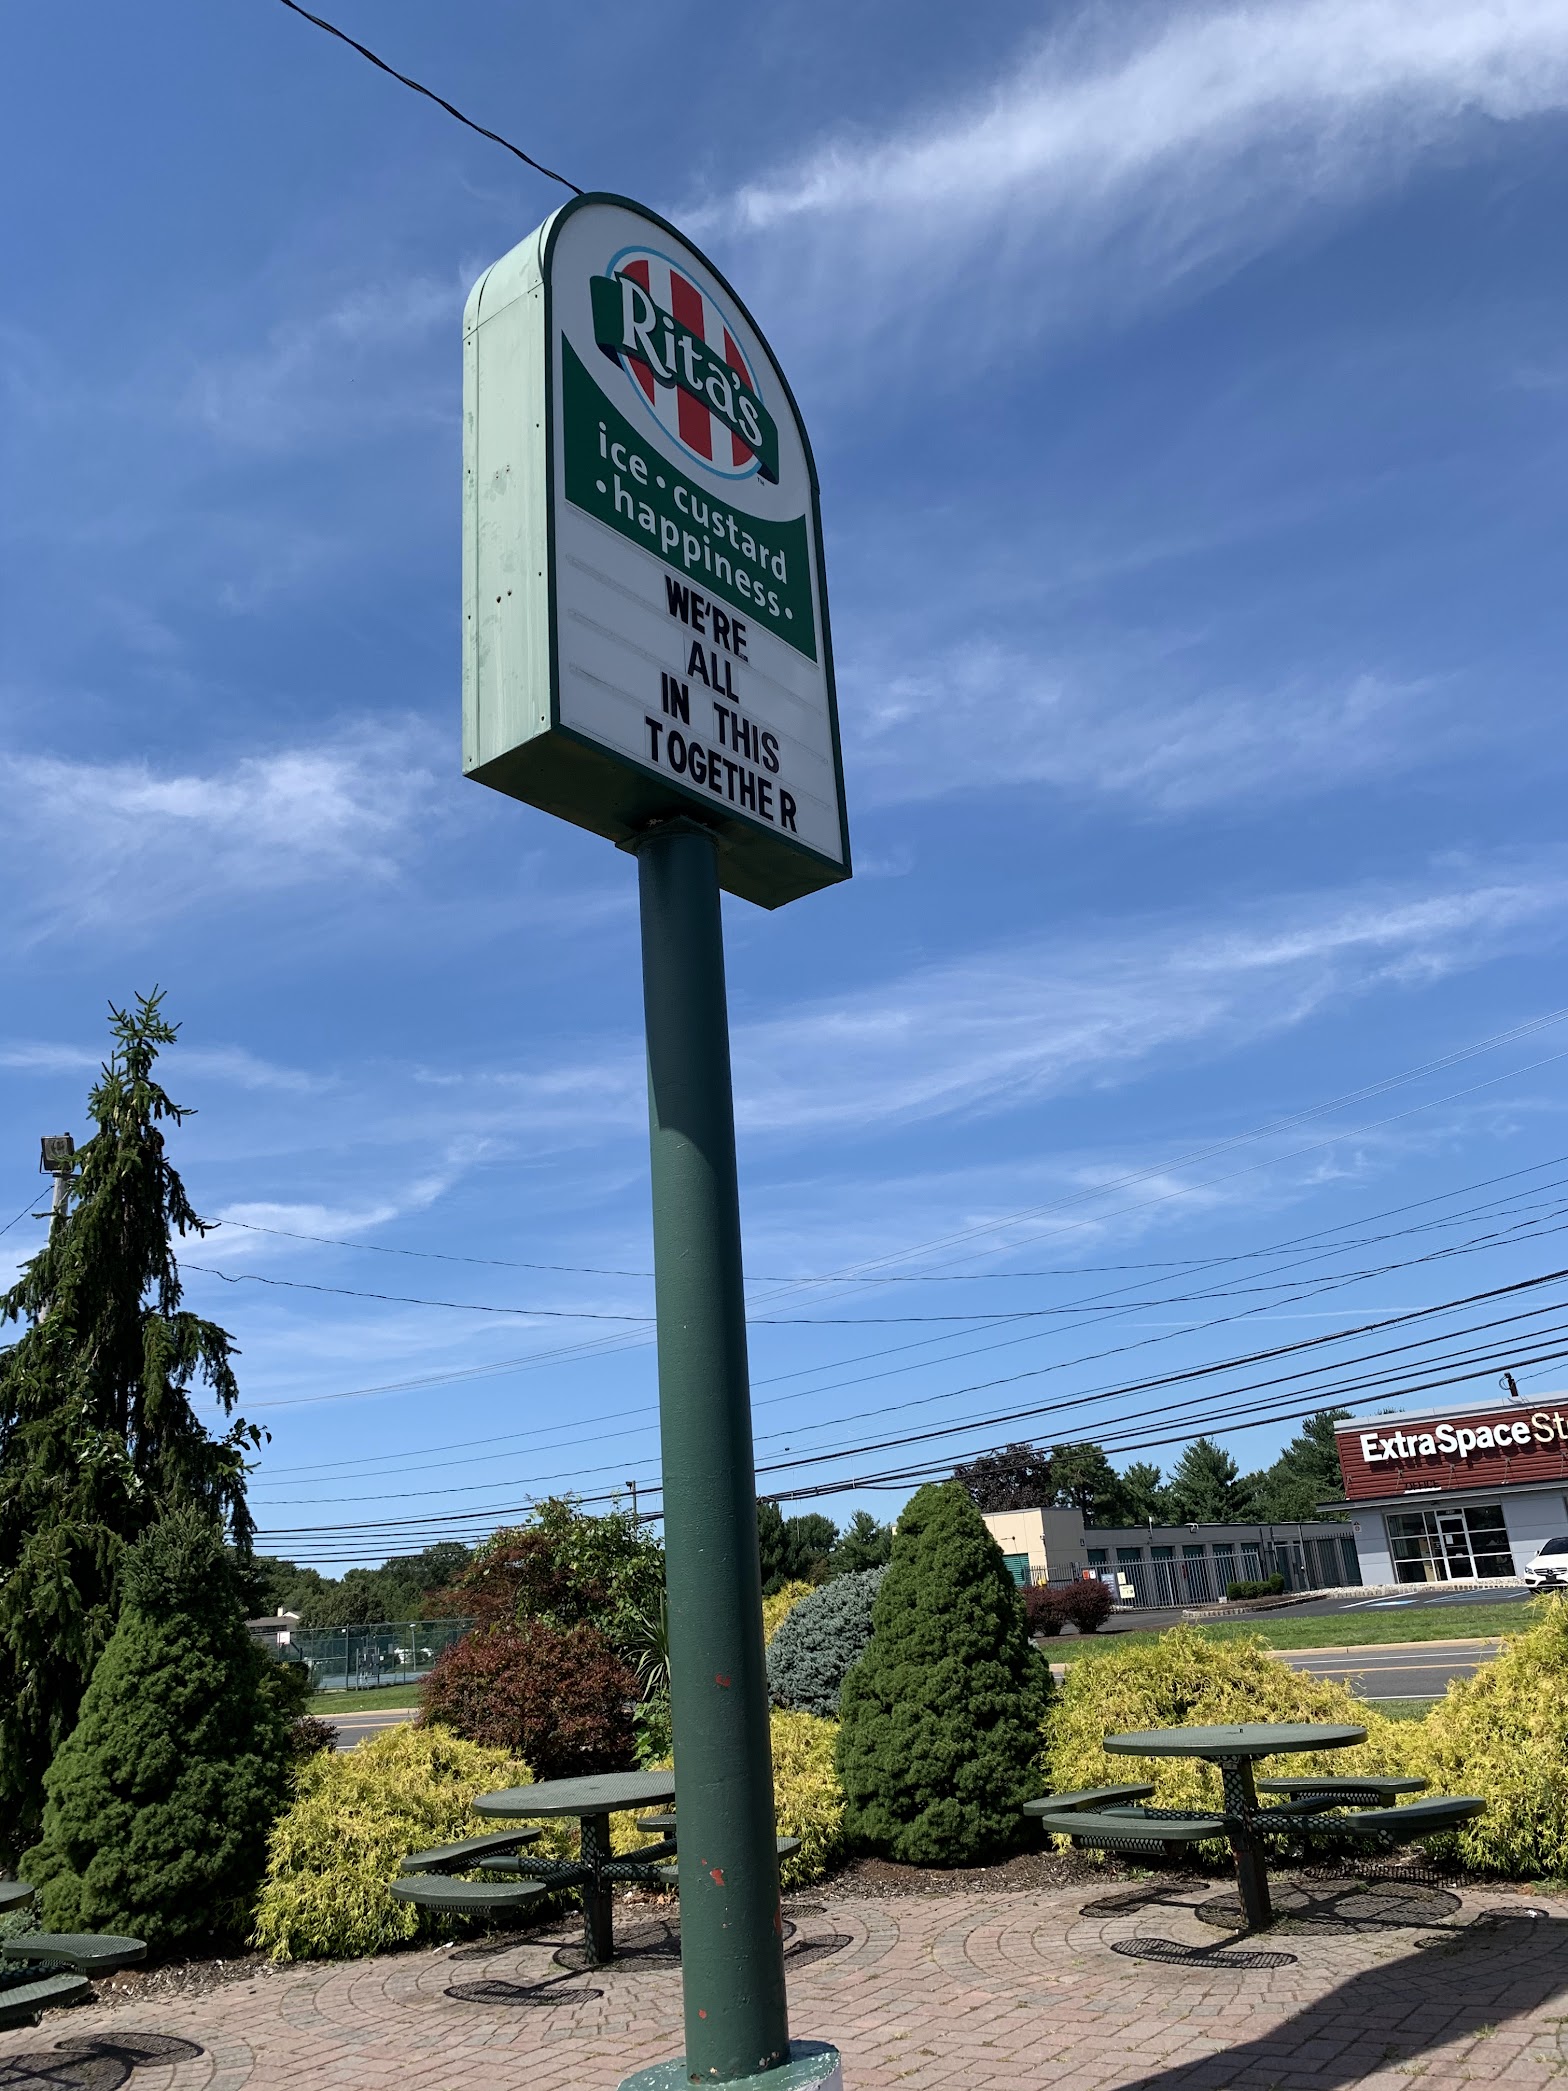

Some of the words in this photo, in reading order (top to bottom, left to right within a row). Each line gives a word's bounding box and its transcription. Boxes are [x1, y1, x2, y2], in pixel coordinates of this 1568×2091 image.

[619, 276, 763, 447] Rita's
[598, 421, 648, 485] ice
[673, 485, 787, 584] custard
[614, 473, 780, 617] happiness
[665, 574, 748, 662] WE'RE
[687, 640, 739, 703] ALL
[661, 672, 690, 725] IN
[713, 702, 779, 774] THIS
[1531, 1411, 1568, 1443] St
